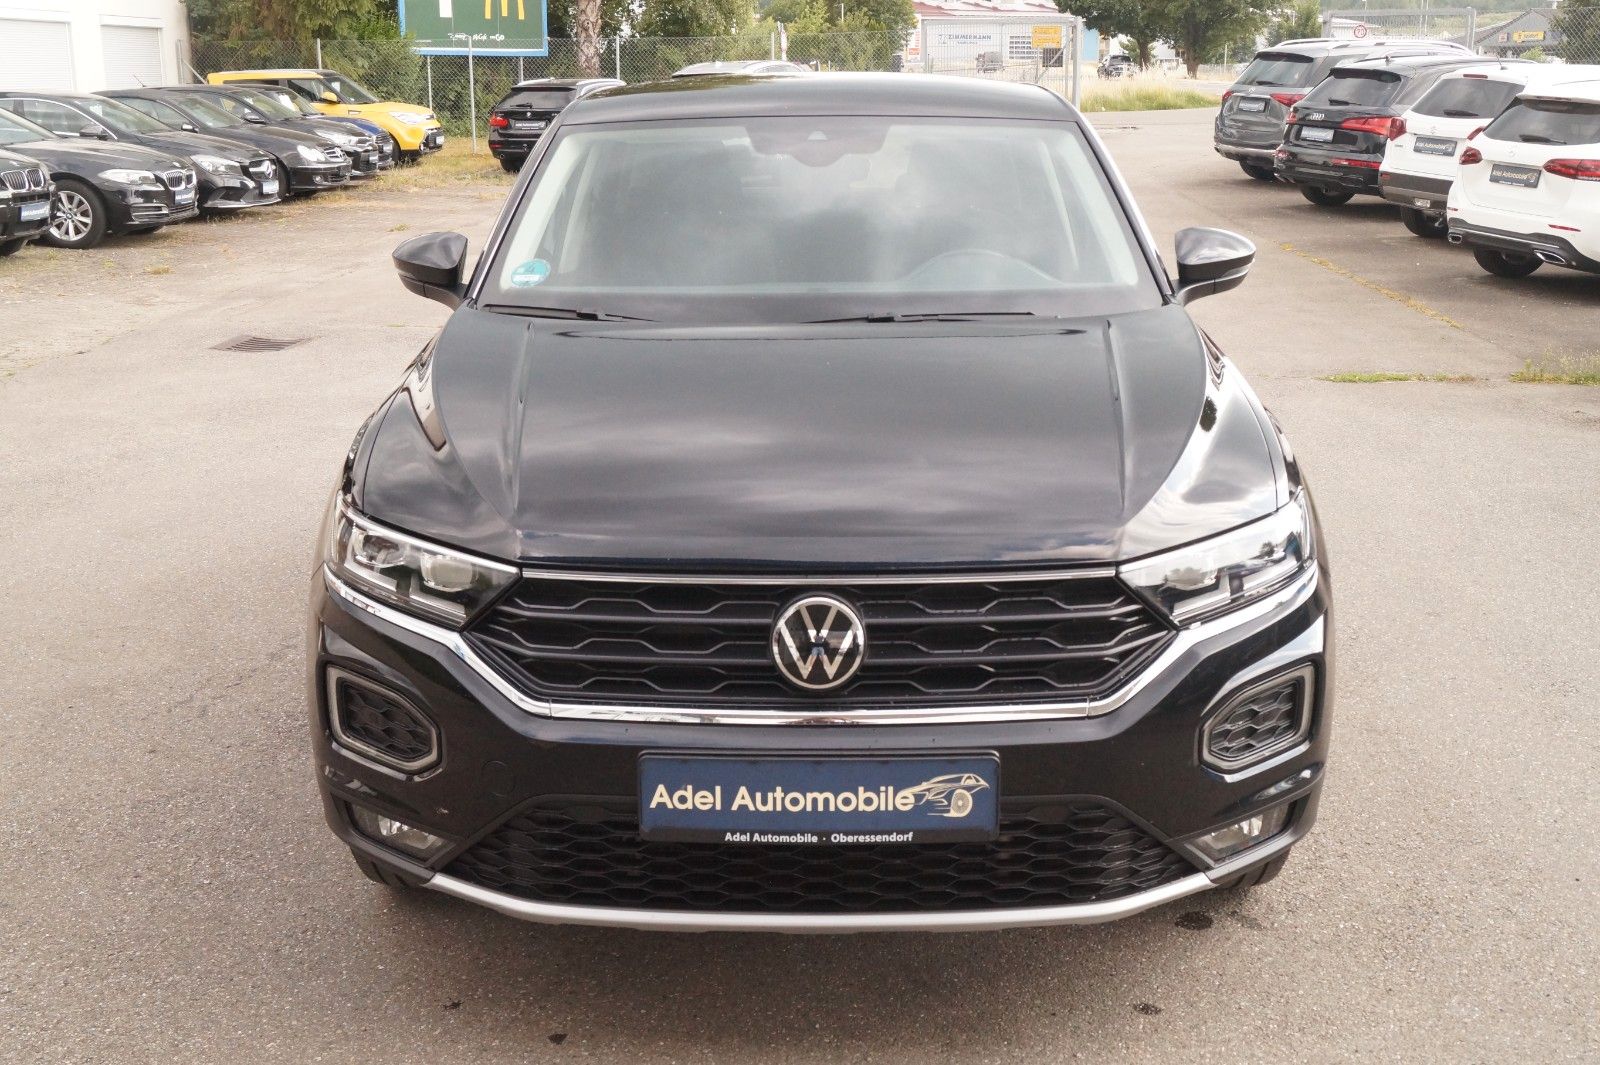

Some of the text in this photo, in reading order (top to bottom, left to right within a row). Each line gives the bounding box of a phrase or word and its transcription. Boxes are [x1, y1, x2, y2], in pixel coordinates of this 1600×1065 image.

[649, 784, 916, 813] Adel Automobile
[724, 832, 914, 843] Adel Automobile Oberessendorf
